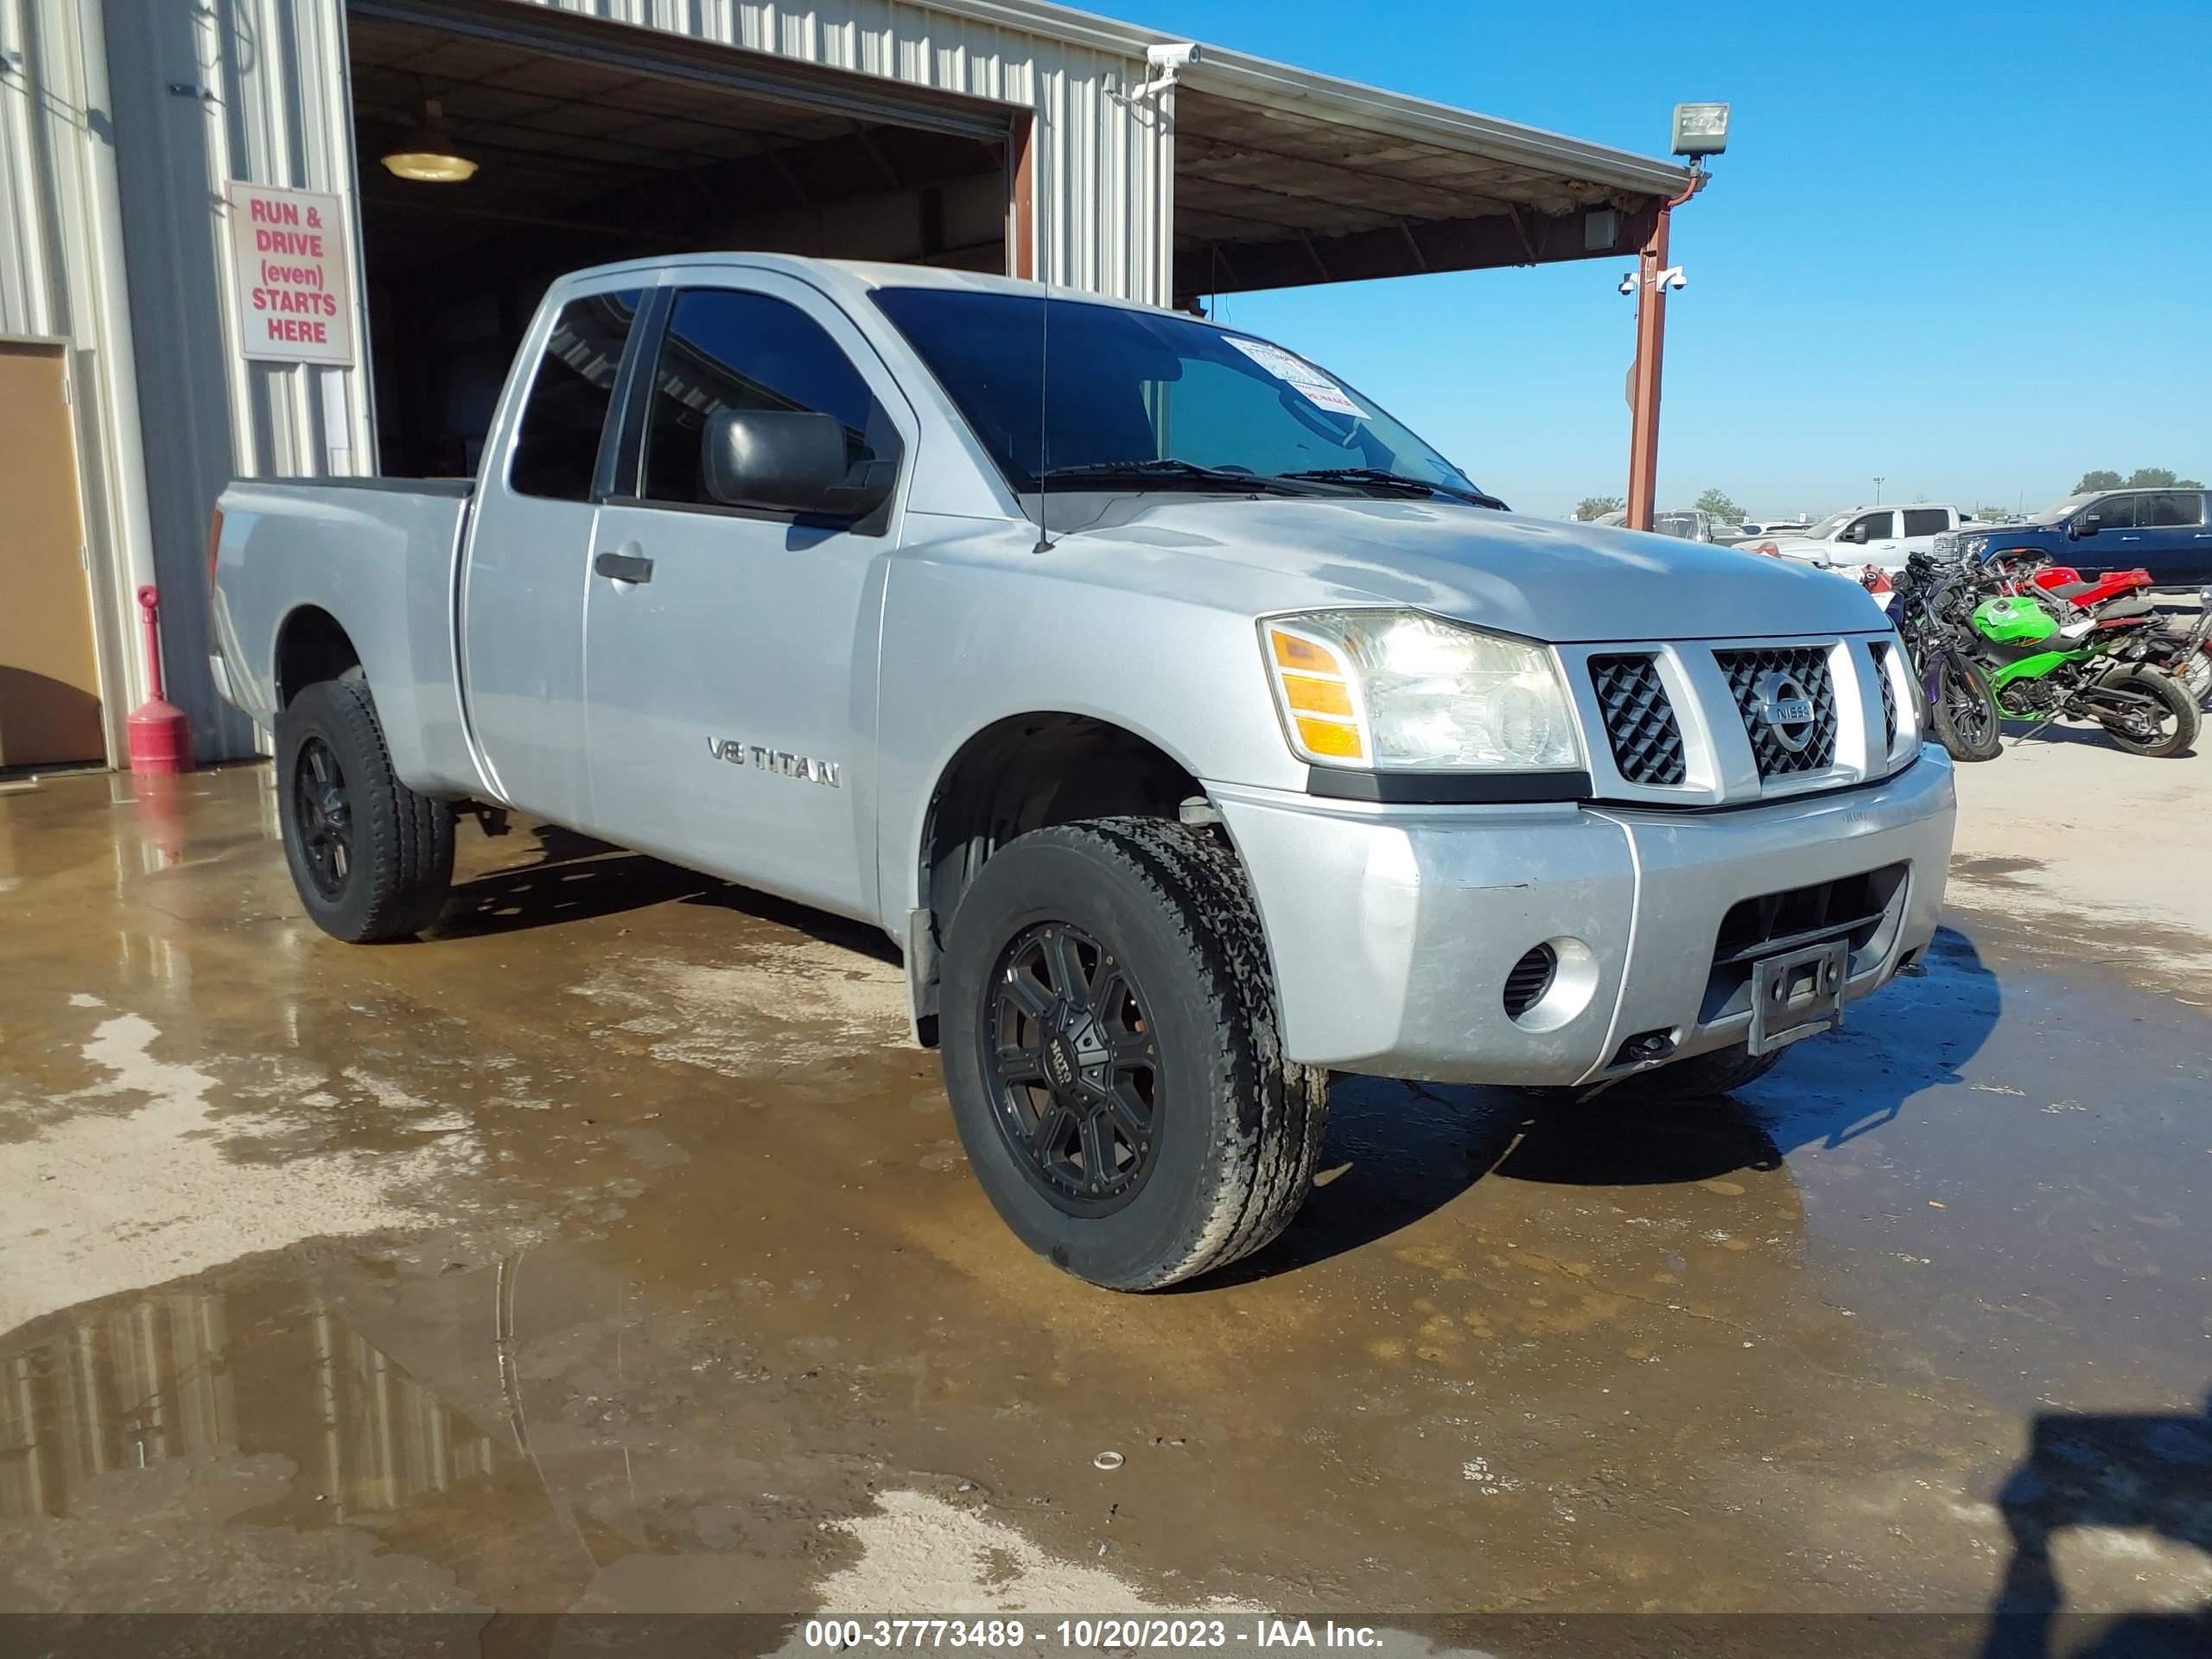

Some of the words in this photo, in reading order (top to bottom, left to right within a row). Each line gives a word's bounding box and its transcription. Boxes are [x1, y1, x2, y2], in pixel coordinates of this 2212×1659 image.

[251, 199, 299, 226] RUN
[307, 207, 323, 229] &
[256, 229, 323, 257] DRIVE
[261, 259, 324, 291] (even)
[252, 287, 337, 316] STARTS
[267, 317, 327, 343] HERE
[708, 736, 745, 766] V8
[751, 746, 841, 788] TITAN
